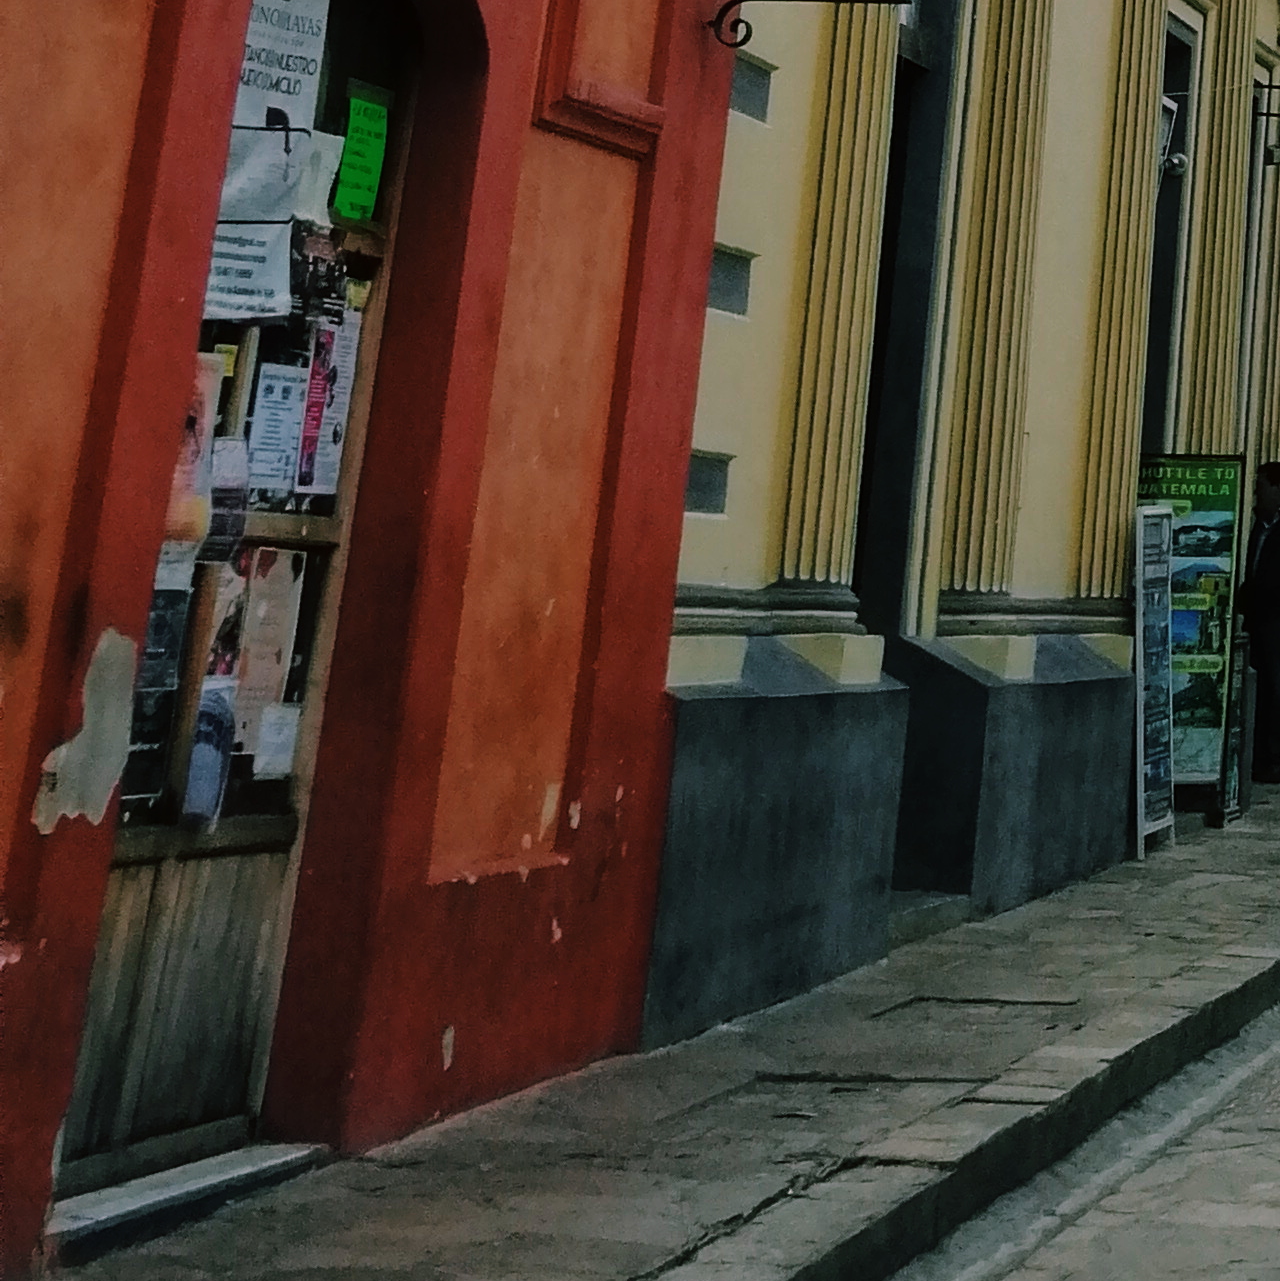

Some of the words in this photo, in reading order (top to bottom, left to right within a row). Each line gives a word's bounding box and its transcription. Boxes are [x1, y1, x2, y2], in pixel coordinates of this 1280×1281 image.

[1141, 467, 1208, 479] HUTTLE
[1215, 468, 1235, 480] TO
[1138, 483, 1231, 495] UATEMALA
